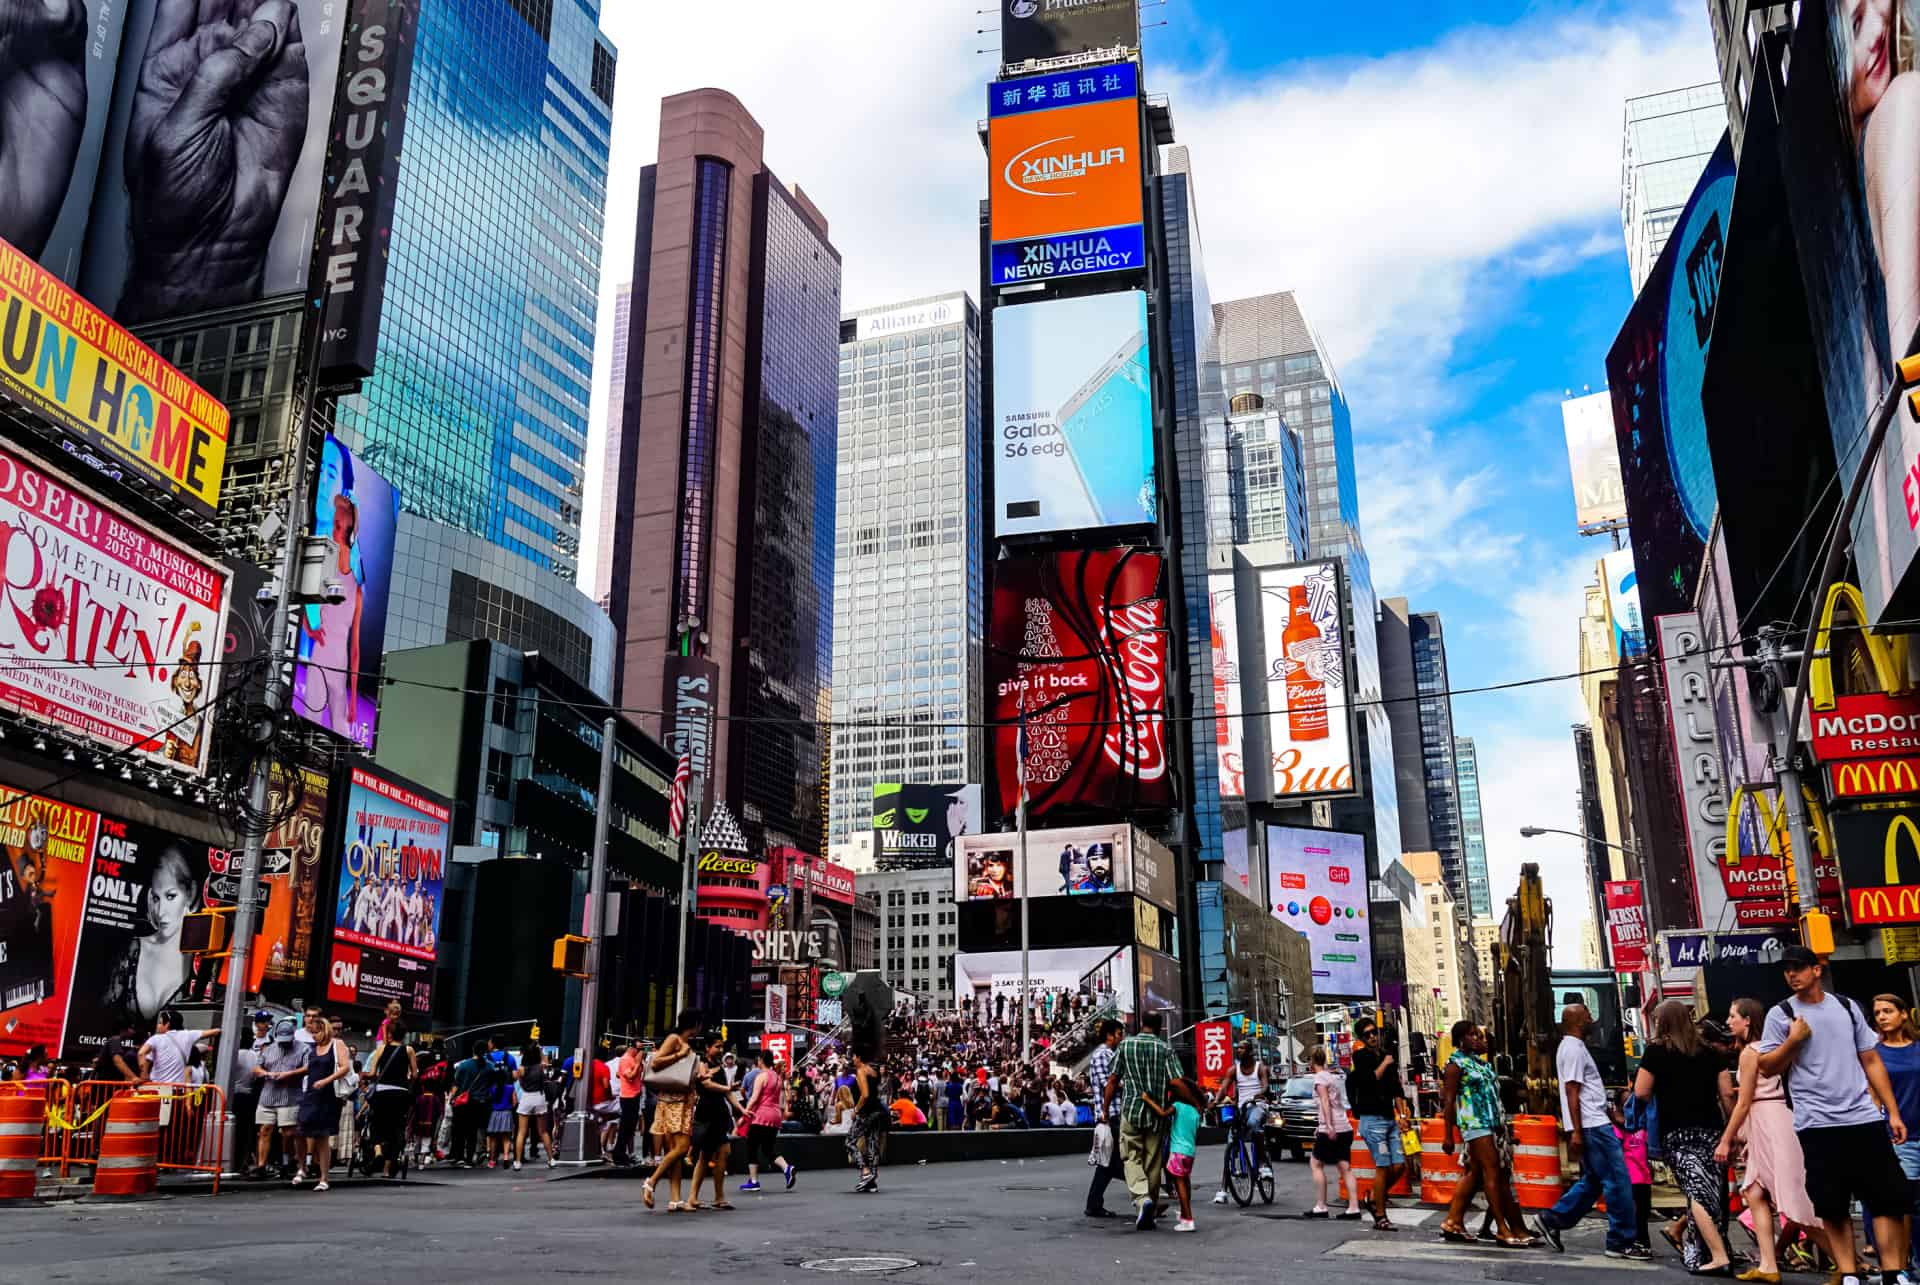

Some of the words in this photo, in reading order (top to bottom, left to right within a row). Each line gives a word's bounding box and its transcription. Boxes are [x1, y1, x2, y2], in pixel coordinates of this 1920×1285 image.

[1002, 73, 1122, 107] 新华通讯社
[327, 24, 387, 295] SQUARE
[1021, 147, 1125, 177] XINHUA
[1023, 236, 1112, 264] XINHUA
[1003, 260, 1056, 280] NEWS
[1057, 250, 1133, 273] AGENCY
[0, 290, 77, 404] UN
[39, 276, 70, 321] 2015
[72, 299, 108, 346] BEST
[107, 318, 159, 388] MUSICAL
[160, 366, 192, 409] TONY
[190, 391, 227, 431] AWARD
[1003, 422, 1061, 439] Galax
[1005, 411, 1051, 423] SAMSUNG
[1005, 441, 1028, 457] S6
[17, 511, 168, 607] SOMETHING
[108, 518, 146, 548] BEST
[149, 542, 215, 590] MUSICAL!
[105, 536, 131, 561] 2015
[134, 553, 168, 582] TONY
[169, 571, 213, 603] AWARD
[33, 676, 44, 691] IN
[45, 680, 58, 695] AT
[58, 685, 86, 709] LEAST
[87, 699, 103, 714] 400
[70, 677, 113, 703] FUNNIEST
[113, 695, 148, 717] MUSICAL
[997, 675, 1030, 697] give
[1033, 674, 1047, 689] it
[1049, 672, 1088, 687] back
[1674, 631, 1728, 866] PALACE
[101, 818, 128, 837] THE
[383, 815, 407, 832] MUSICAL
[46, 837, 86, 865] WINNER
[99, 835, 139, 864] ONE
[400, 845, 442, 881] TOWN
[697, 851, 758, 875] Reese's
[95, 858, 122, 877] THE
[1330, 867, 1348, 881] Gift
[92, 874, 144, 905] ONLY
[216, 881, 238, 896] ONE
[826, 874, 853, 893] PLAZA
[1609, 904, 1645, 926] JERSEY
[1740, 908, 1775, 919] OPEN
[1616, 923, 1644, 942] BOYS
[331, 960, 359, 988] CNN
[360, 973, 372, 983] CNN
[373, 975, 385, 985] GOP
[384, 977, 404, 990] DEBATE
[1204, 1025, 1226, 1072] tkts
